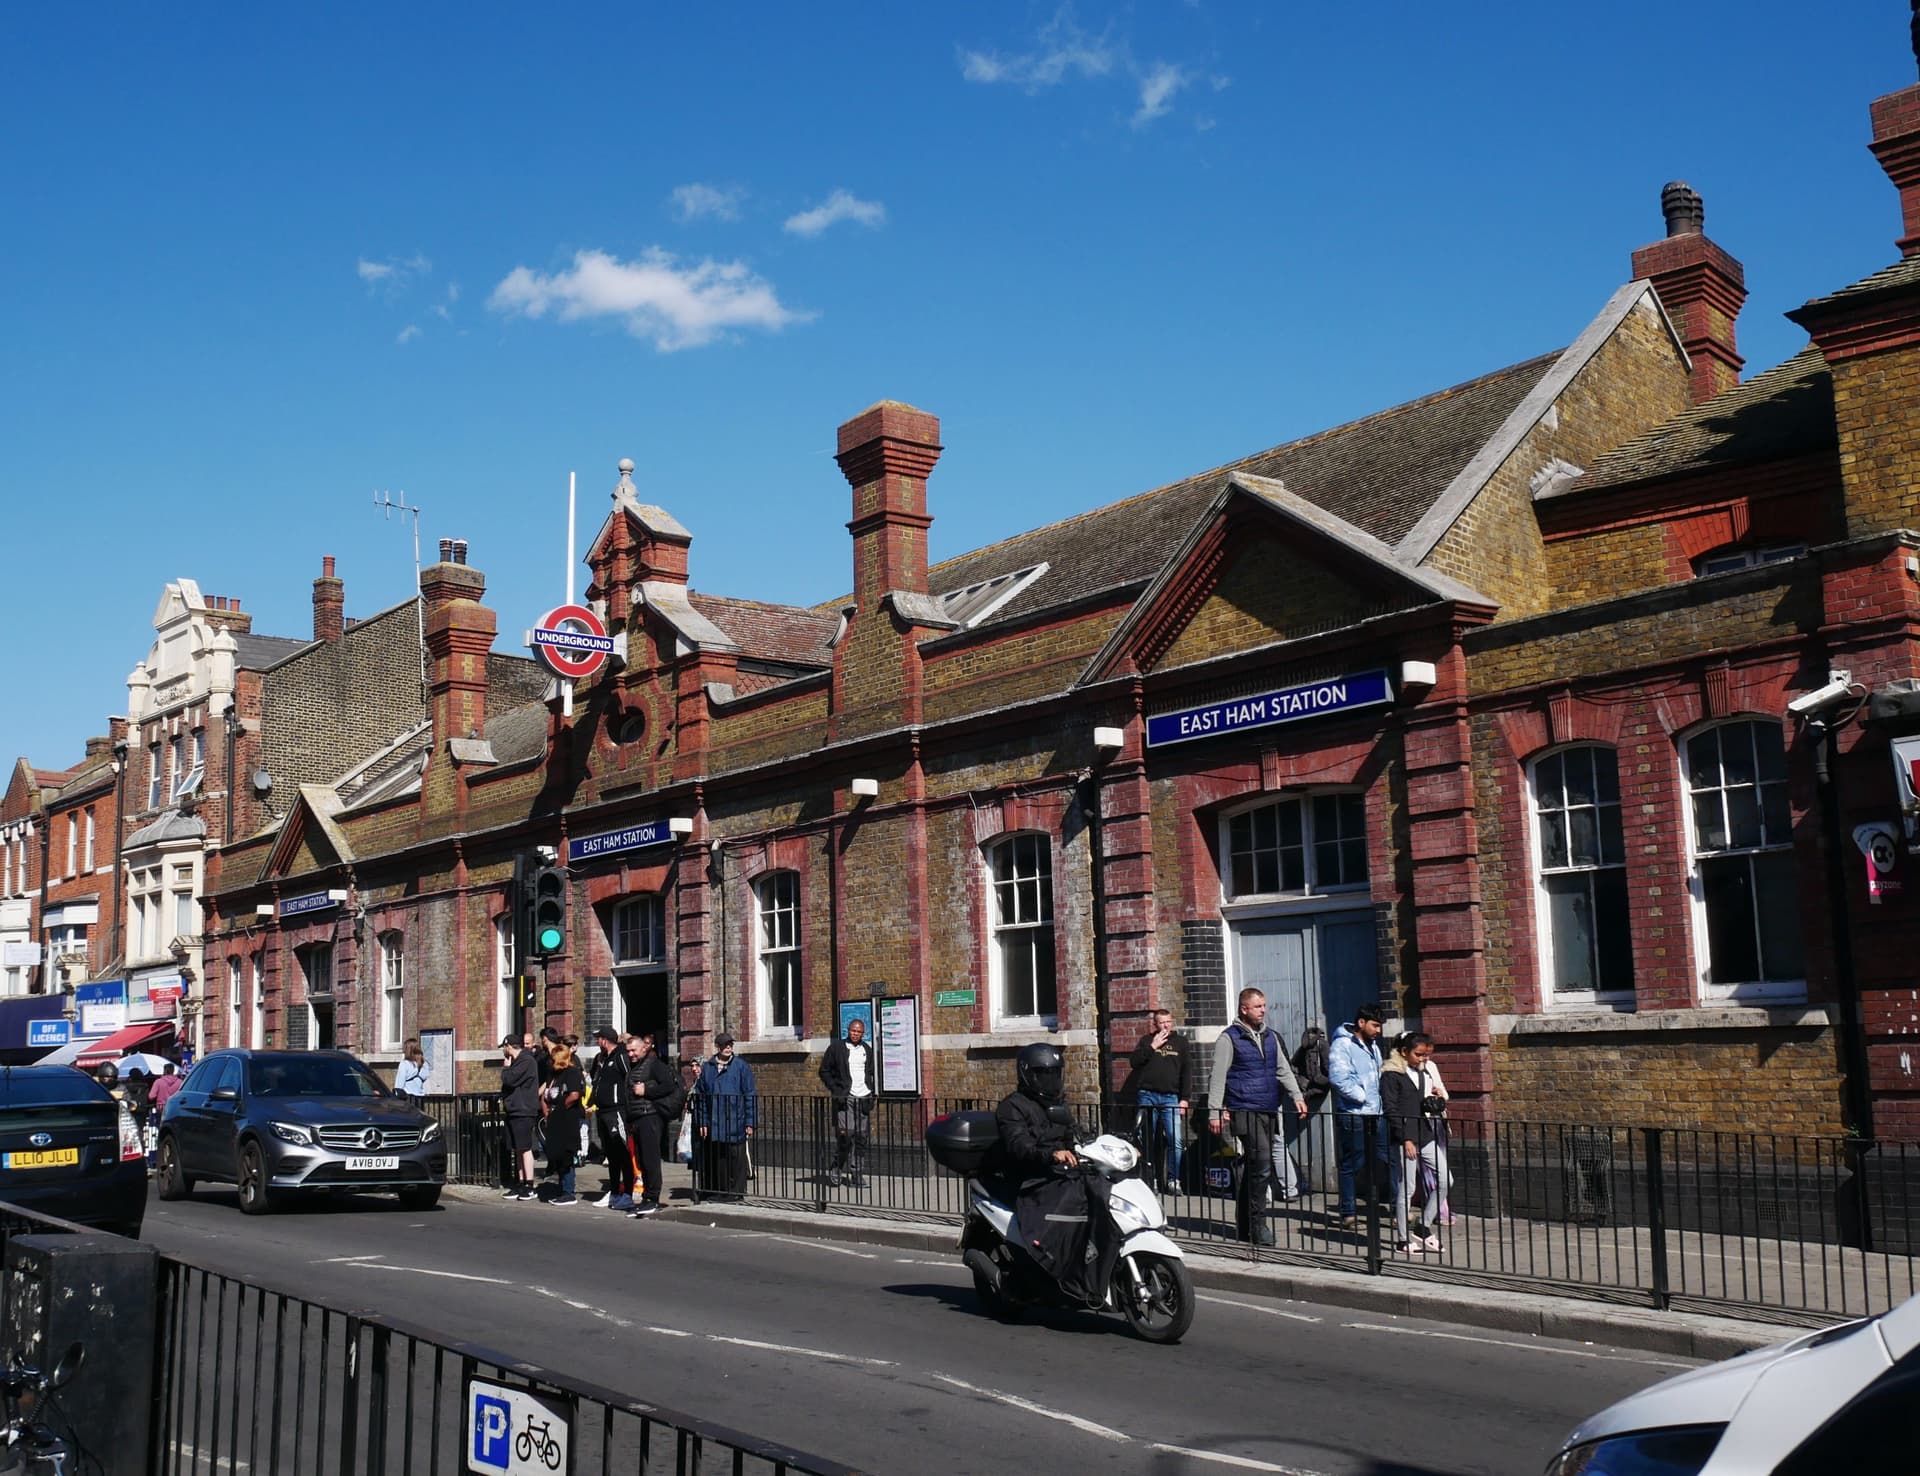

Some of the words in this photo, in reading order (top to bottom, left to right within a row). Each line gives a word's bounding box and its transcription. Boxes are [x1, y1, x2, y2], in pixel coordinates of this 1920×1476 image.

[536, 631, 611, 649] UNDERGROUND
[1180, 710, 1221, 734] EAST
[1226, 701, 1266, 725] HAM
[1271, 684, 1347, 716] STATION
[583, 839, 602, 853] EAST
[603, 834, 621, 849] HAM
[622, 827, 656, 845] STATION
[286, 900, 299, 912] EAST
[298, 898, 309, 910] HAM
[308, 895, 328, 908] STATION
[41, 1024, 57, 1034] OFF
[32, 1033, 67, 1044] LICENCE
[14, 1151, 44, 1166] LL10
[48, 1150, 73, 1163] JLU
[352, 1158, 374, 1168] AV18
[375, 1158, 394, 1168] OVJ
[483, 1403, 507, 1457] P
